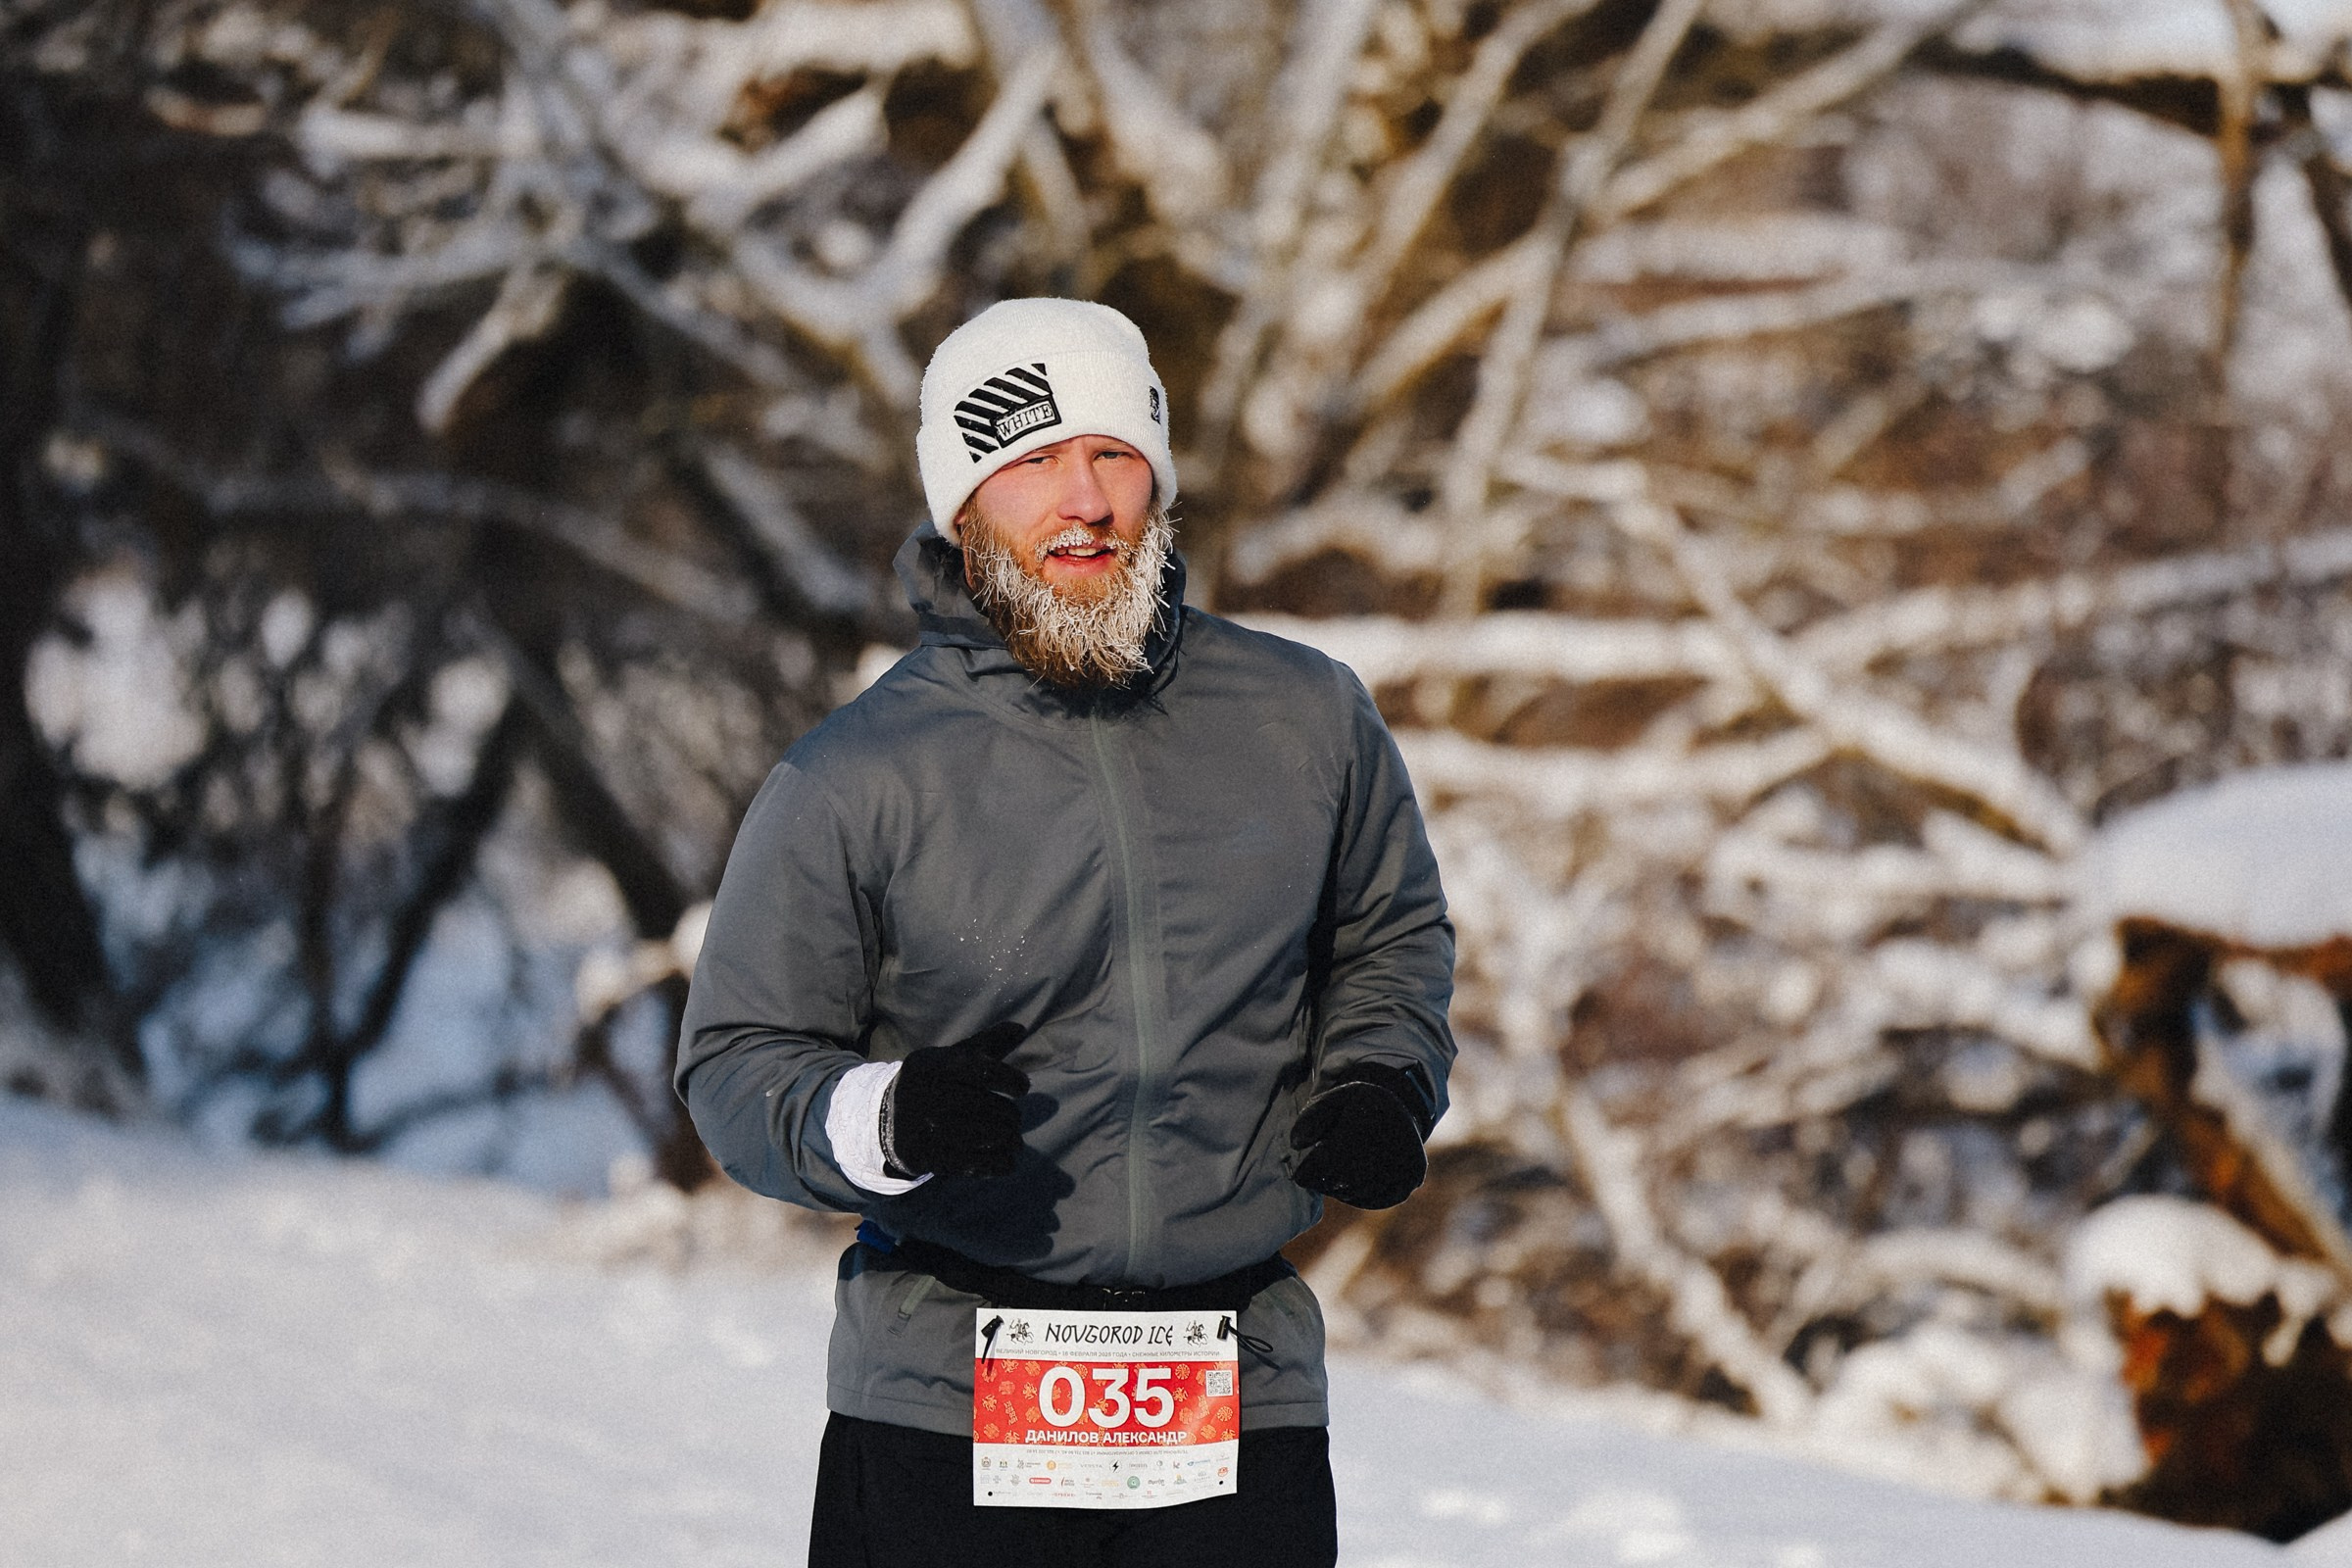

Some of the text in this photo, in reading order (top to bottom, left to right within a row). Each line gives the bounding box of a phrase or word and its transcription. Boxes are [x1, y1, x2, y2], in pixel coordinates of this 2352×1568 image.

[997, 403, 1054, 437] WHITE
[1045, 1323, 1173, 1347] NOVGOROD ICE
[1039, 1366, 1175, 1428] 035
[1025, 1429, 1188, 1445] ДАНИЛОВ АЛЕКСАНДР
